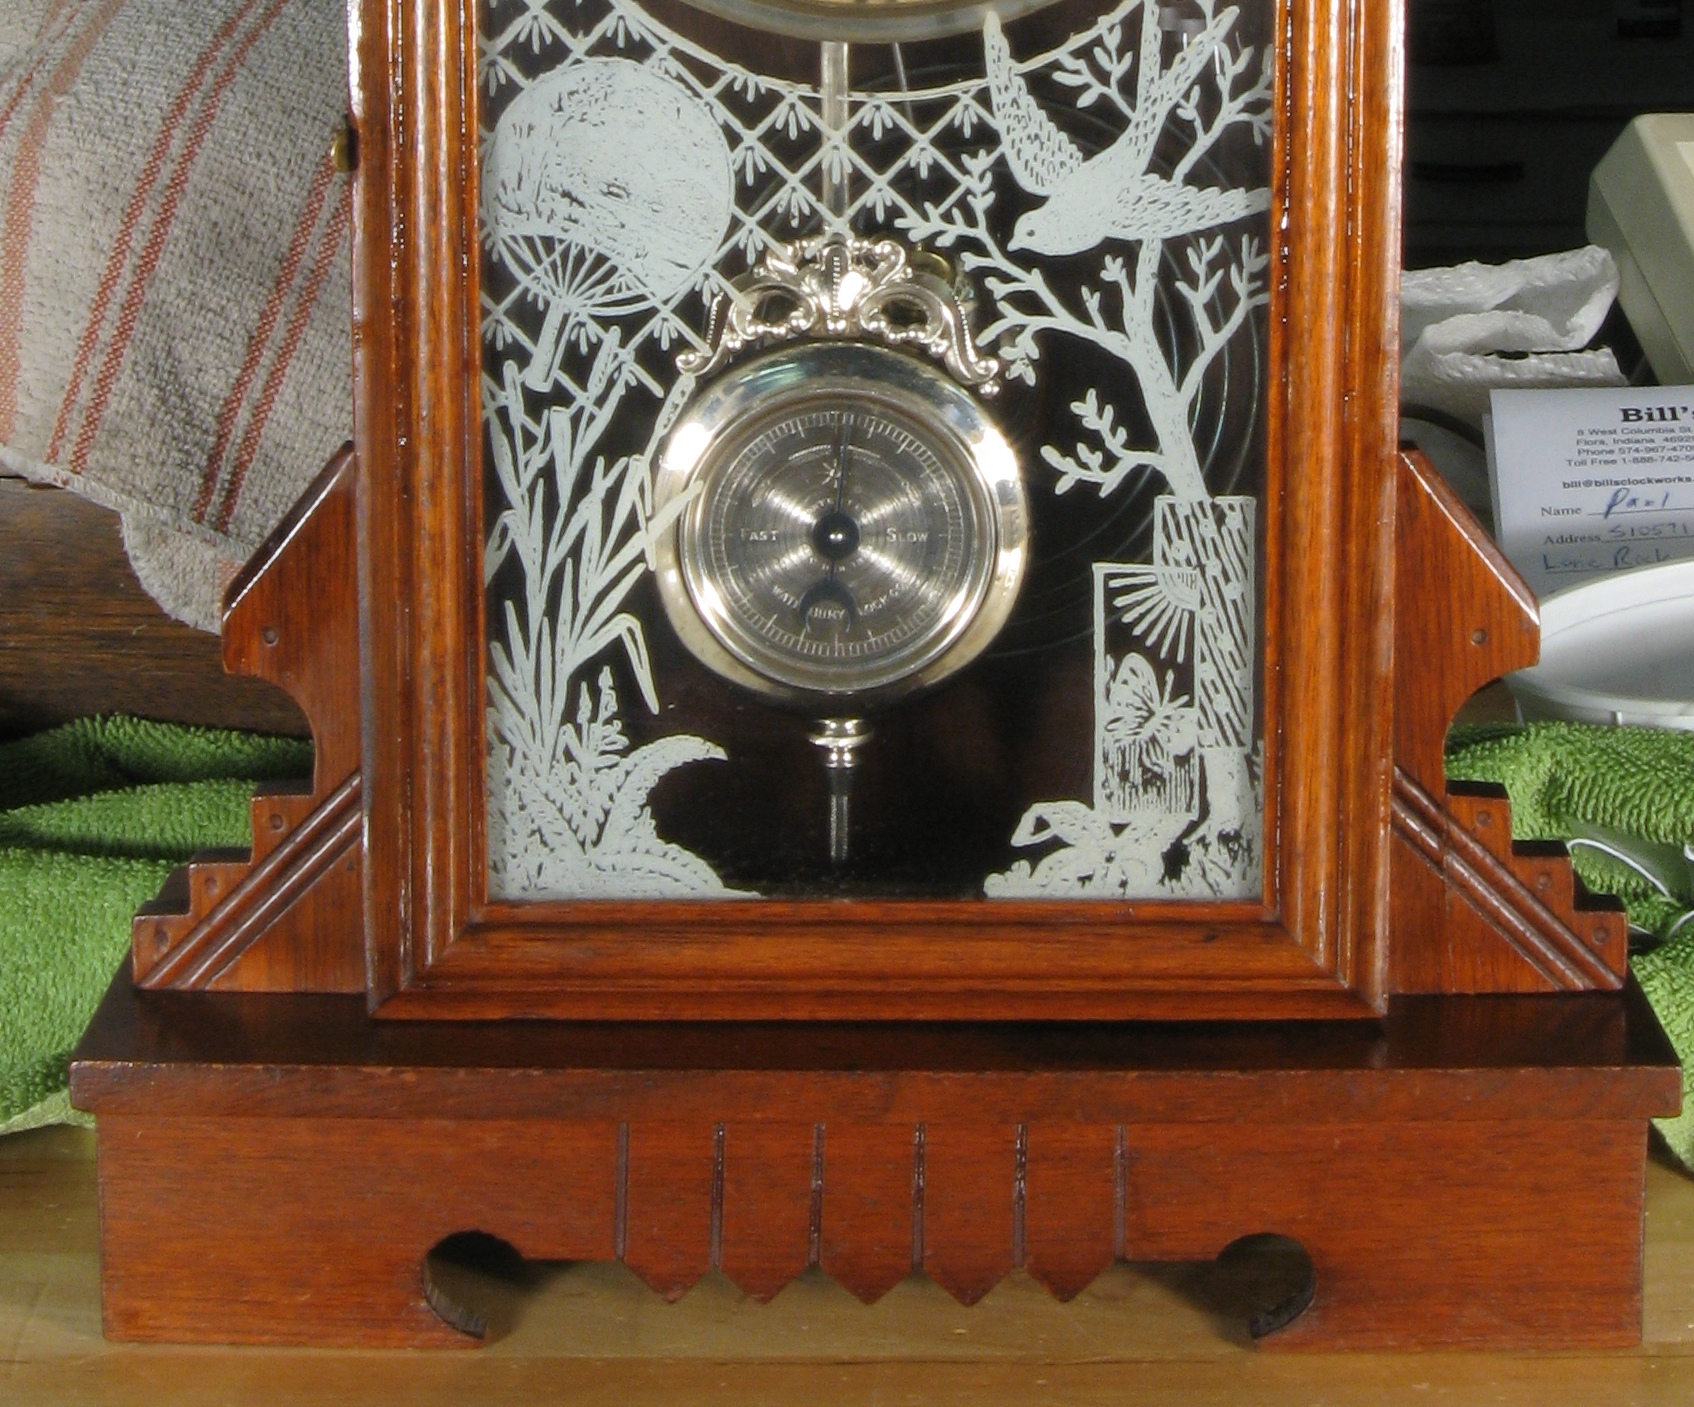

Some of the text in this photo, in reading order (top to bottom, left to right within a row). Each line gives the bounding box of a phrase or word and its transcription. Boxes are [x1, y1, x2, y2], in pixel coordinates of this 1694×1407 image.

[1619, 405, 1694, 422] Bill'
[1588, 428, 1617, 436] West
[1621, 426, 1676, 435] Columbia
[1613, 437, 1655, 445] Indiana
[1577, 447, 1615, 456] Phone
[1566, 459, 1587, 467] Toll
[1590, 458, 1618, 466] Free
[1540, 506, 1582, 517] Name
[1543, 534, 1602, 545] Address
